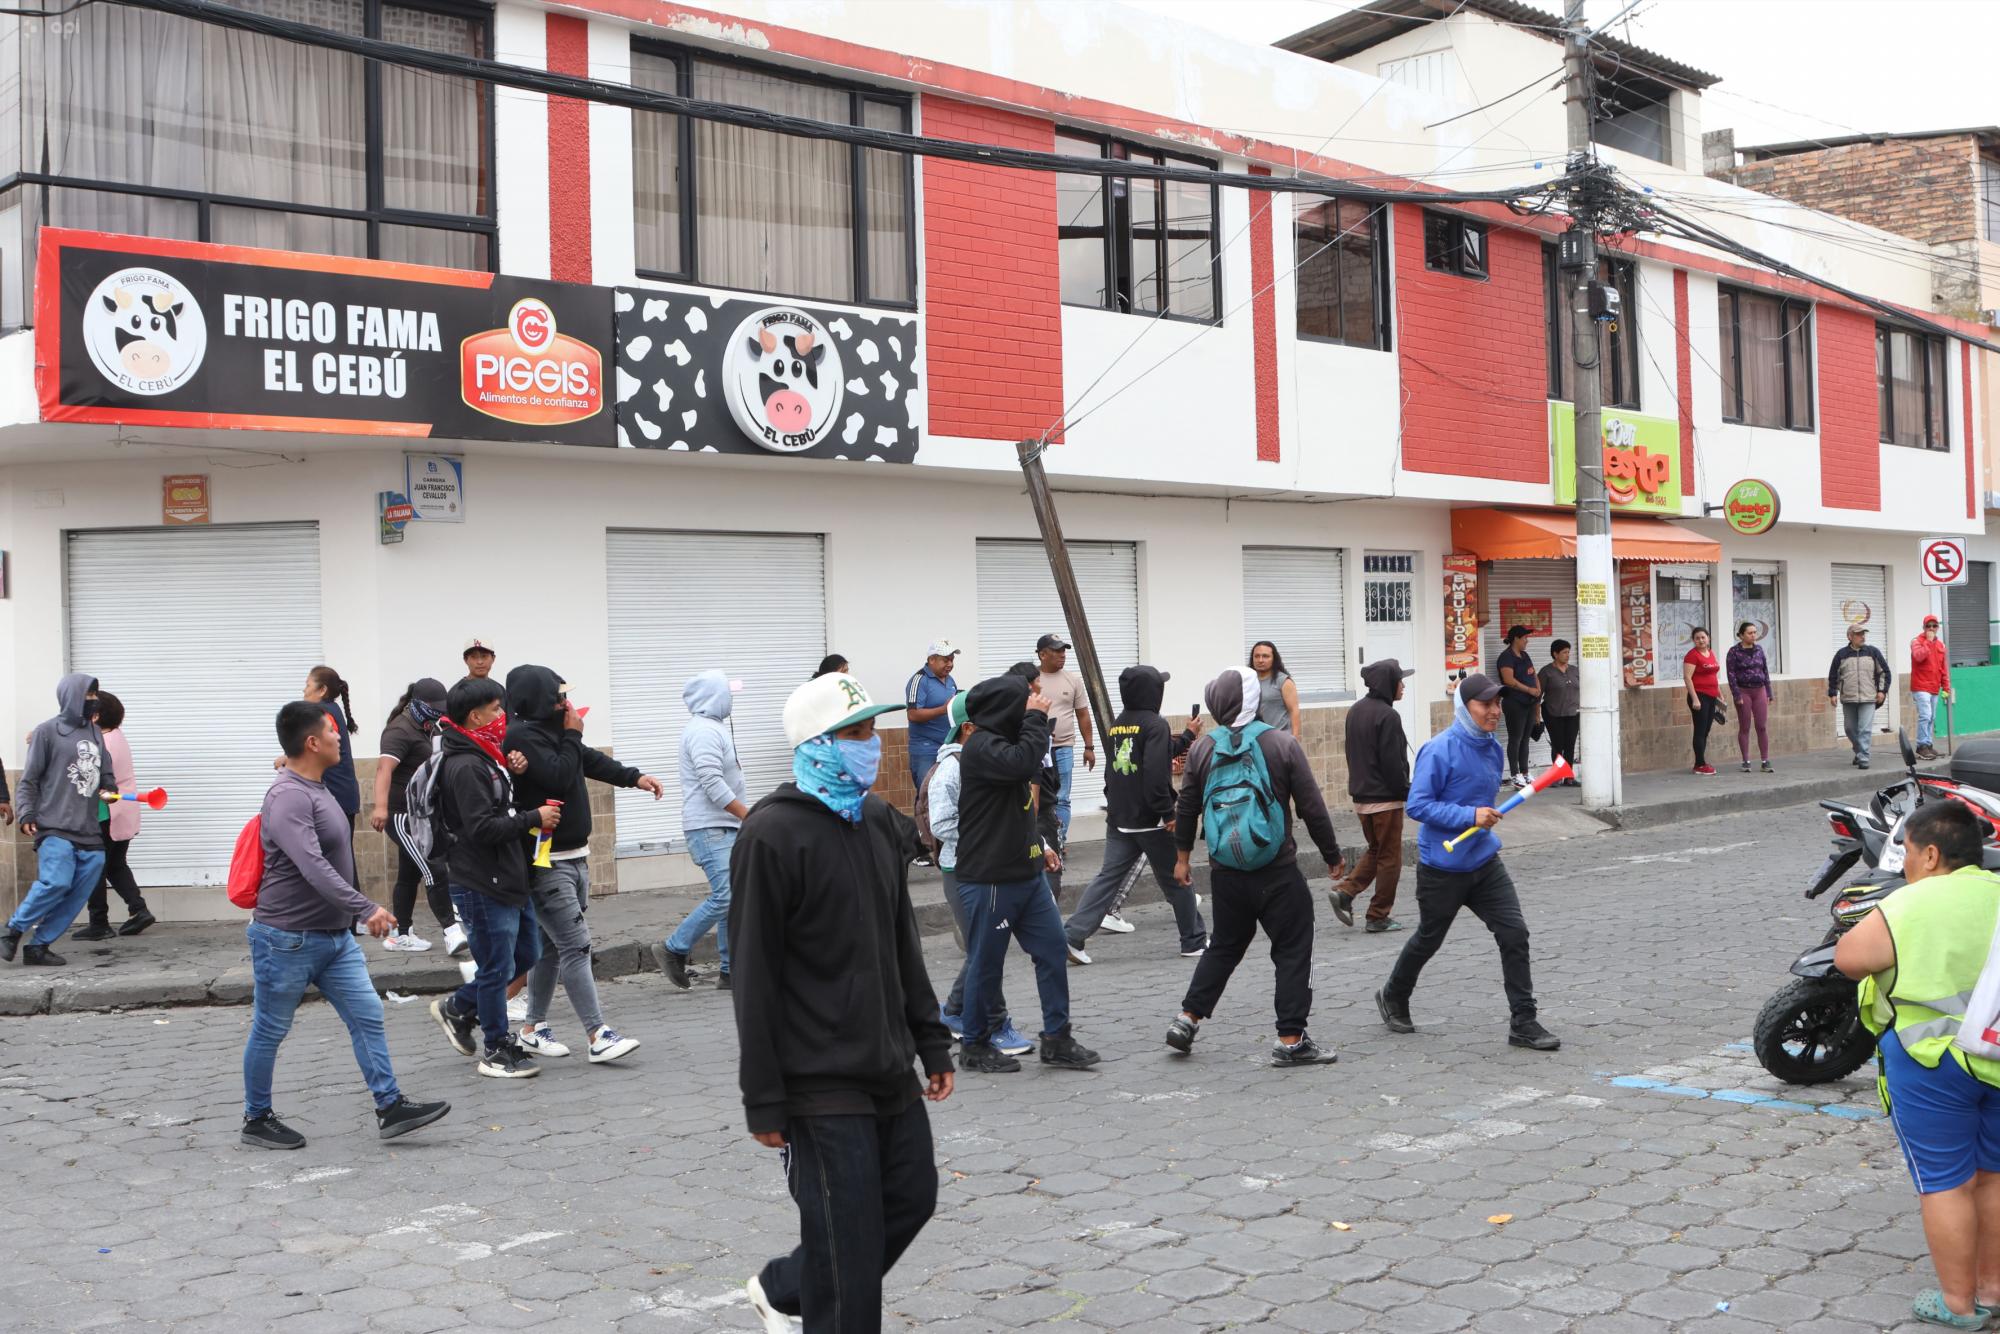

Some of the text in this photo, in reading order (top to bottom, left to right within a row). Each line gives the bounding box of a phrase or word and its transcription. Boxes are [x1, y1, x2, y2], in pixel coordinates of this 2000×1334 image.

[120, 275, 170, 289] FRIGO FAMA
[223, 293, 443, 352] FRIGO FAMA
[762, 313, 814, 333] FRIGO FAMA
[118, 374, 134, 388] EL
[263, 348, 407, 399] EL CEBÚ
[475, 353, 590, 396] PIGGIS
[479, 391, 589, 409] Alimentos de confianza
[763, 425, 779, 444] EL
[1606, 418, 1637, 447] Deli
[1602, 437, 1670, 494] esta
[428, 484, 455, 492] FRANCISCO
[1452, 573, 1467, 652] EMBUTIDOS
[1629, 585, 1648, 679] EMBUTIDOS
